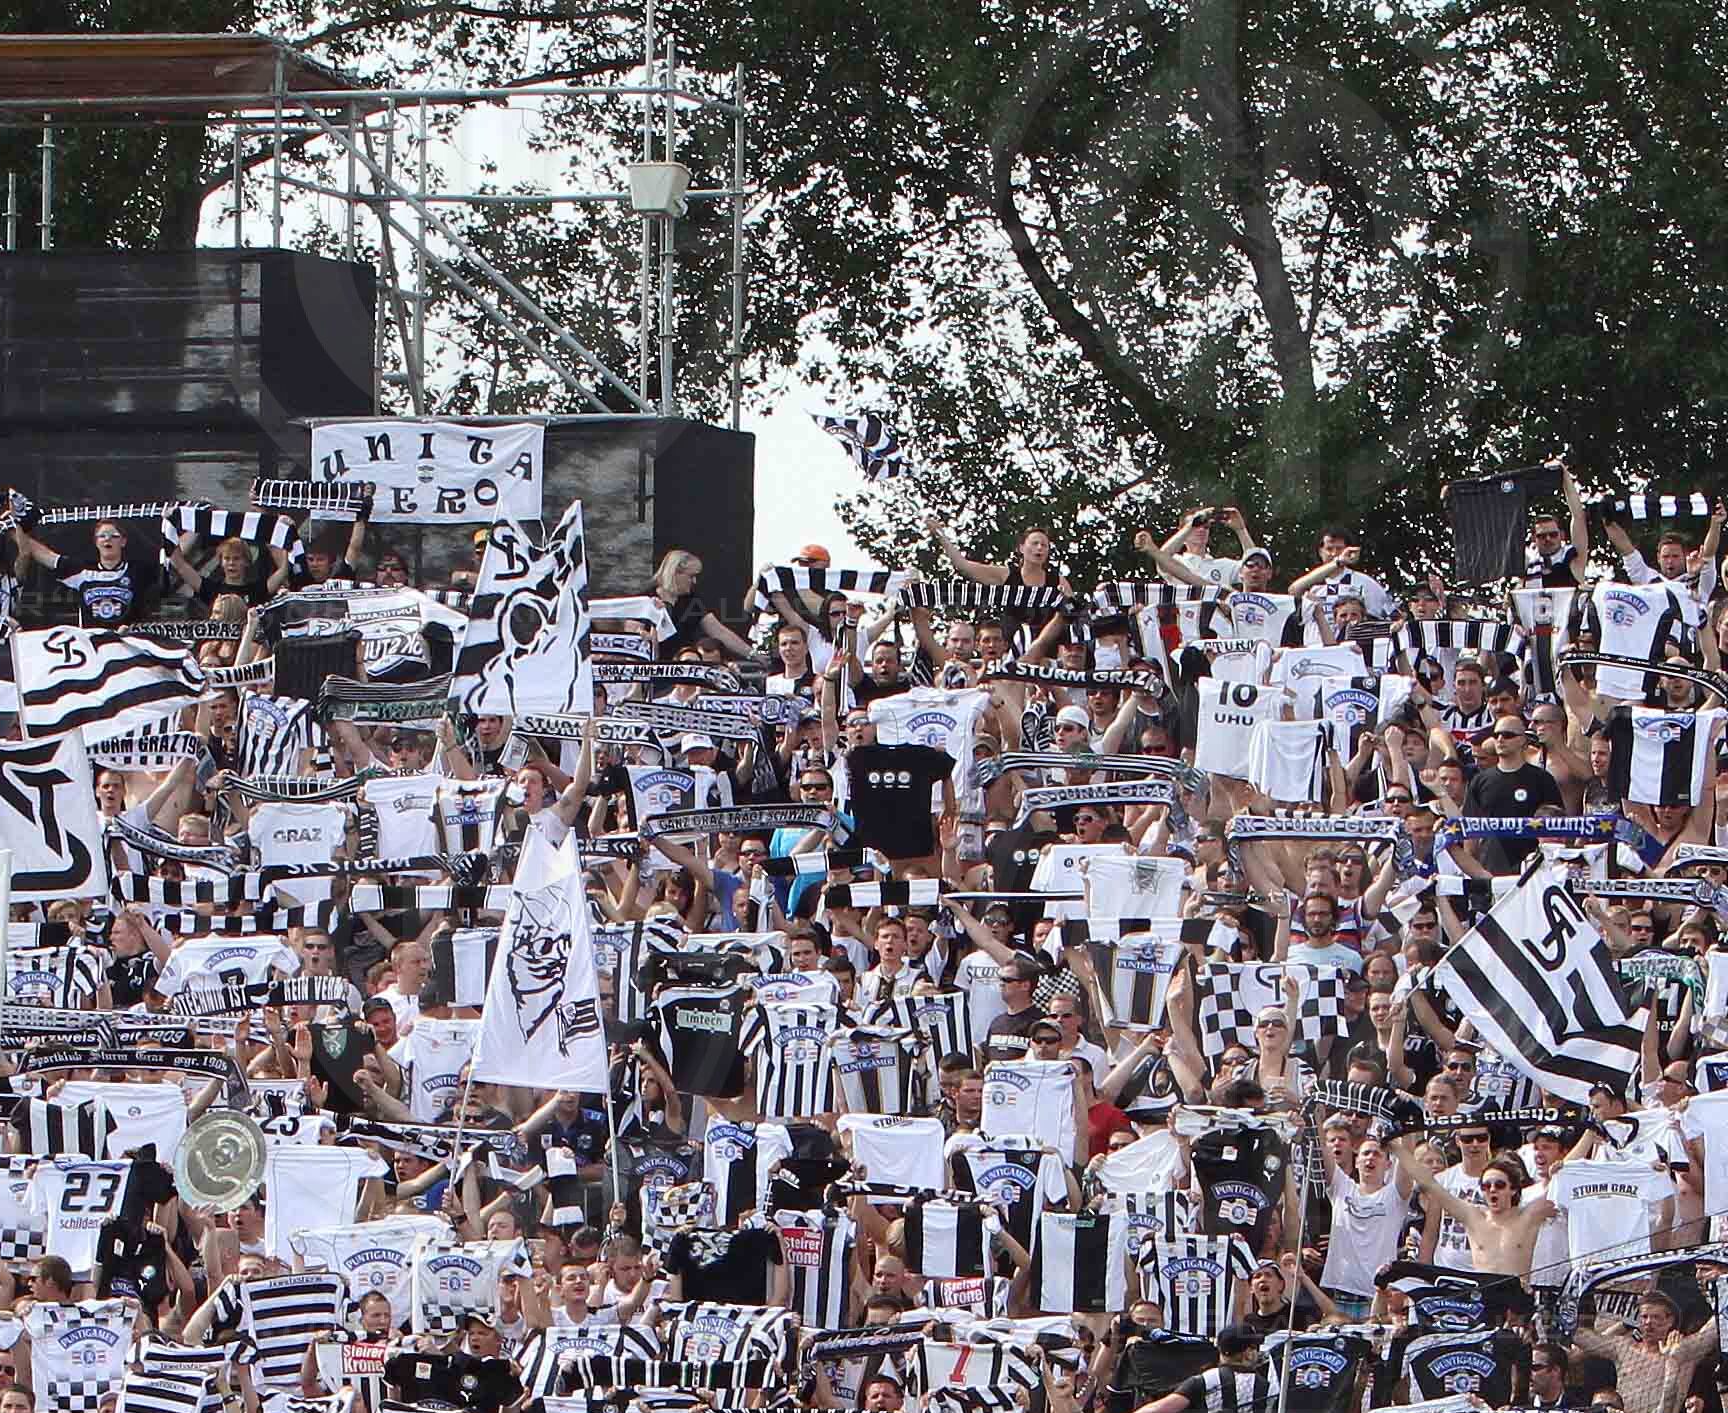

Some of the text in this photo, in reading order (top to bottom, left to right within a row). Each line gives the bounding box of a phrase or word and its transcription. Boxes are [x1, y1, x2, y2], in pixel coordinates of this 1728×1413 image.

[986, 661, 1008, 677] SK
[1014, 663, 1088, 683] STURM
[634, 771, 695, 791] PUNTIGAMER
[978, 1165, 1038, 1189] PUNTIGAMER
[58, 1172, 122, 1212] 23
[1572, 1183, 1640, 1199] STURM GRAZ
[426, 1254, 483, 1276] PUNTIGAMER
[786, 1250, 821, 1266] Krone
[1161, 1257, 1224, 1279] PUNTIGAMER
[58, 1326, 118, 1348] PUNTIGAMER
[342, 1344, 385, 1360] Steirer
[343, 1359, 385, 1375] Krone
[1429, 1352, 1497, 1378] PUNTIGAMER
